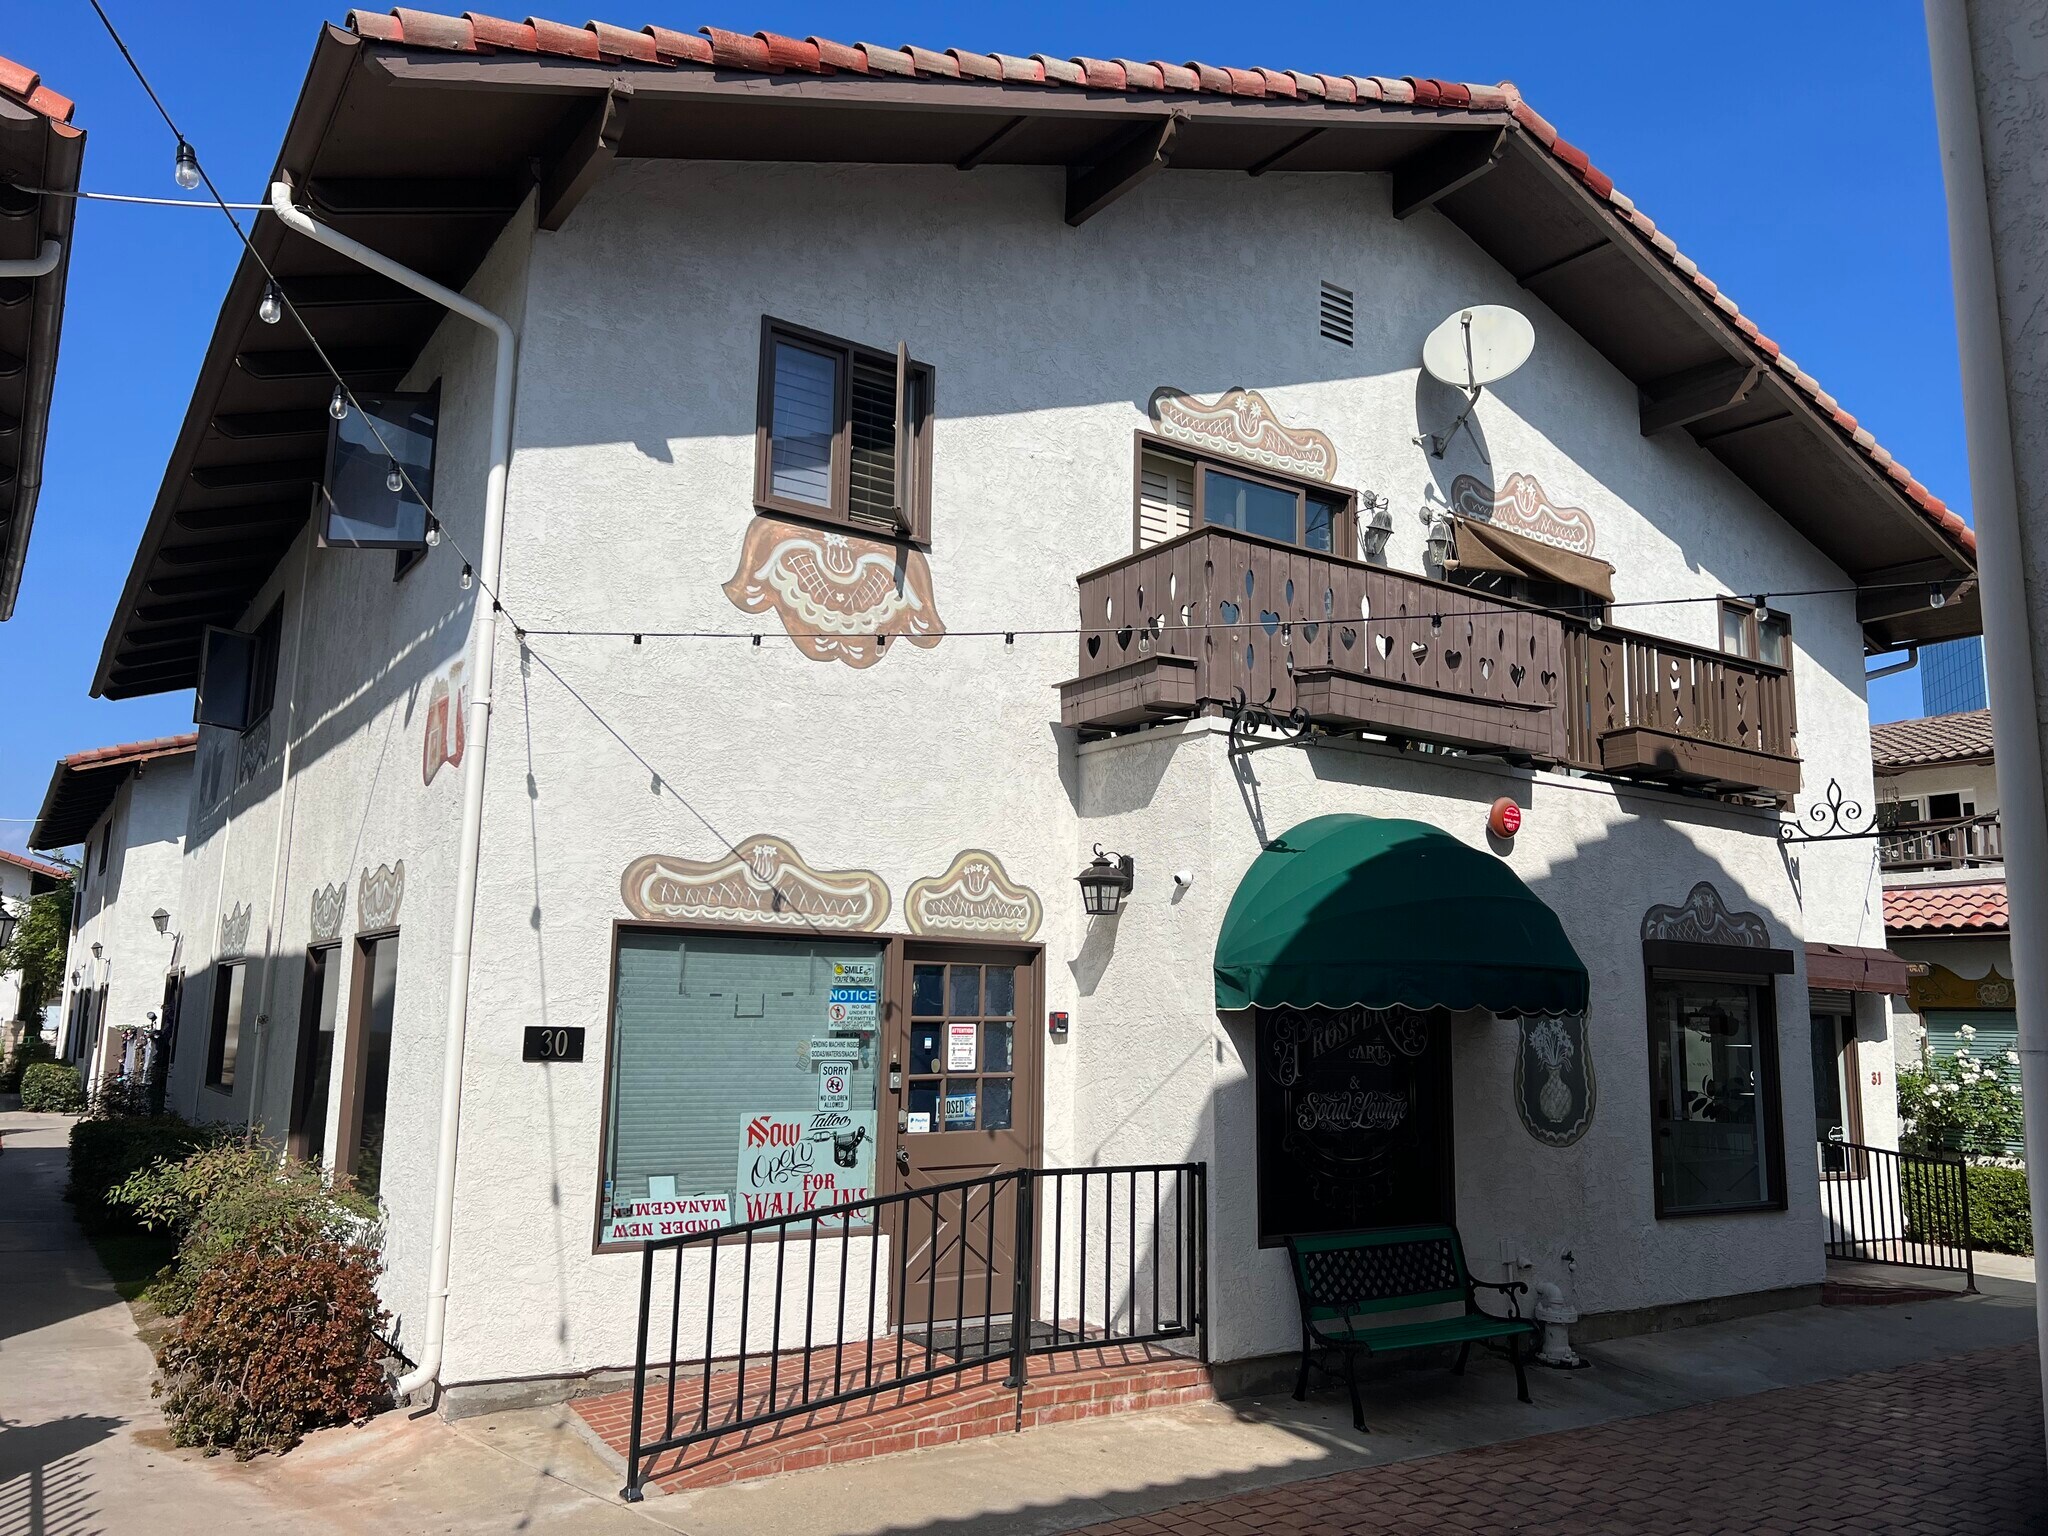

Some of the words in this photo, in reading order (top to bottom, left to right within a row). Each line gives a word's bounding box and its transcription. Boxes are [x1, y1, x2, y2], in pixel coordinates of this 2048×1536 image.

[844, 965, 864, 974] SMILE
[829, 989, 877, 1001] NOTICE
[540, 1029, 569, 1057] 30
[1351, 1045, 1390, 1064] ART
[822, 1066, 849, 1076] SORRY
[1871, 1071, 1882, 1086] 31
[1348, 1075, 1361, 1090] &
[827, 1094, 848, 1102] CHILDREN
[1297, 1091, 1352, 1130] Social
[1351, 1091, 1409, 1130] Lounge
[808, 1112, 852, 1130] Tattoo
[802, 1173, 836, 1191] FOR
[613, 1198, 727, 1218] MANAGEMEN
[612, 1222, 654, 1238] NEW
[659, 1219, 721, 1235] UNDER
